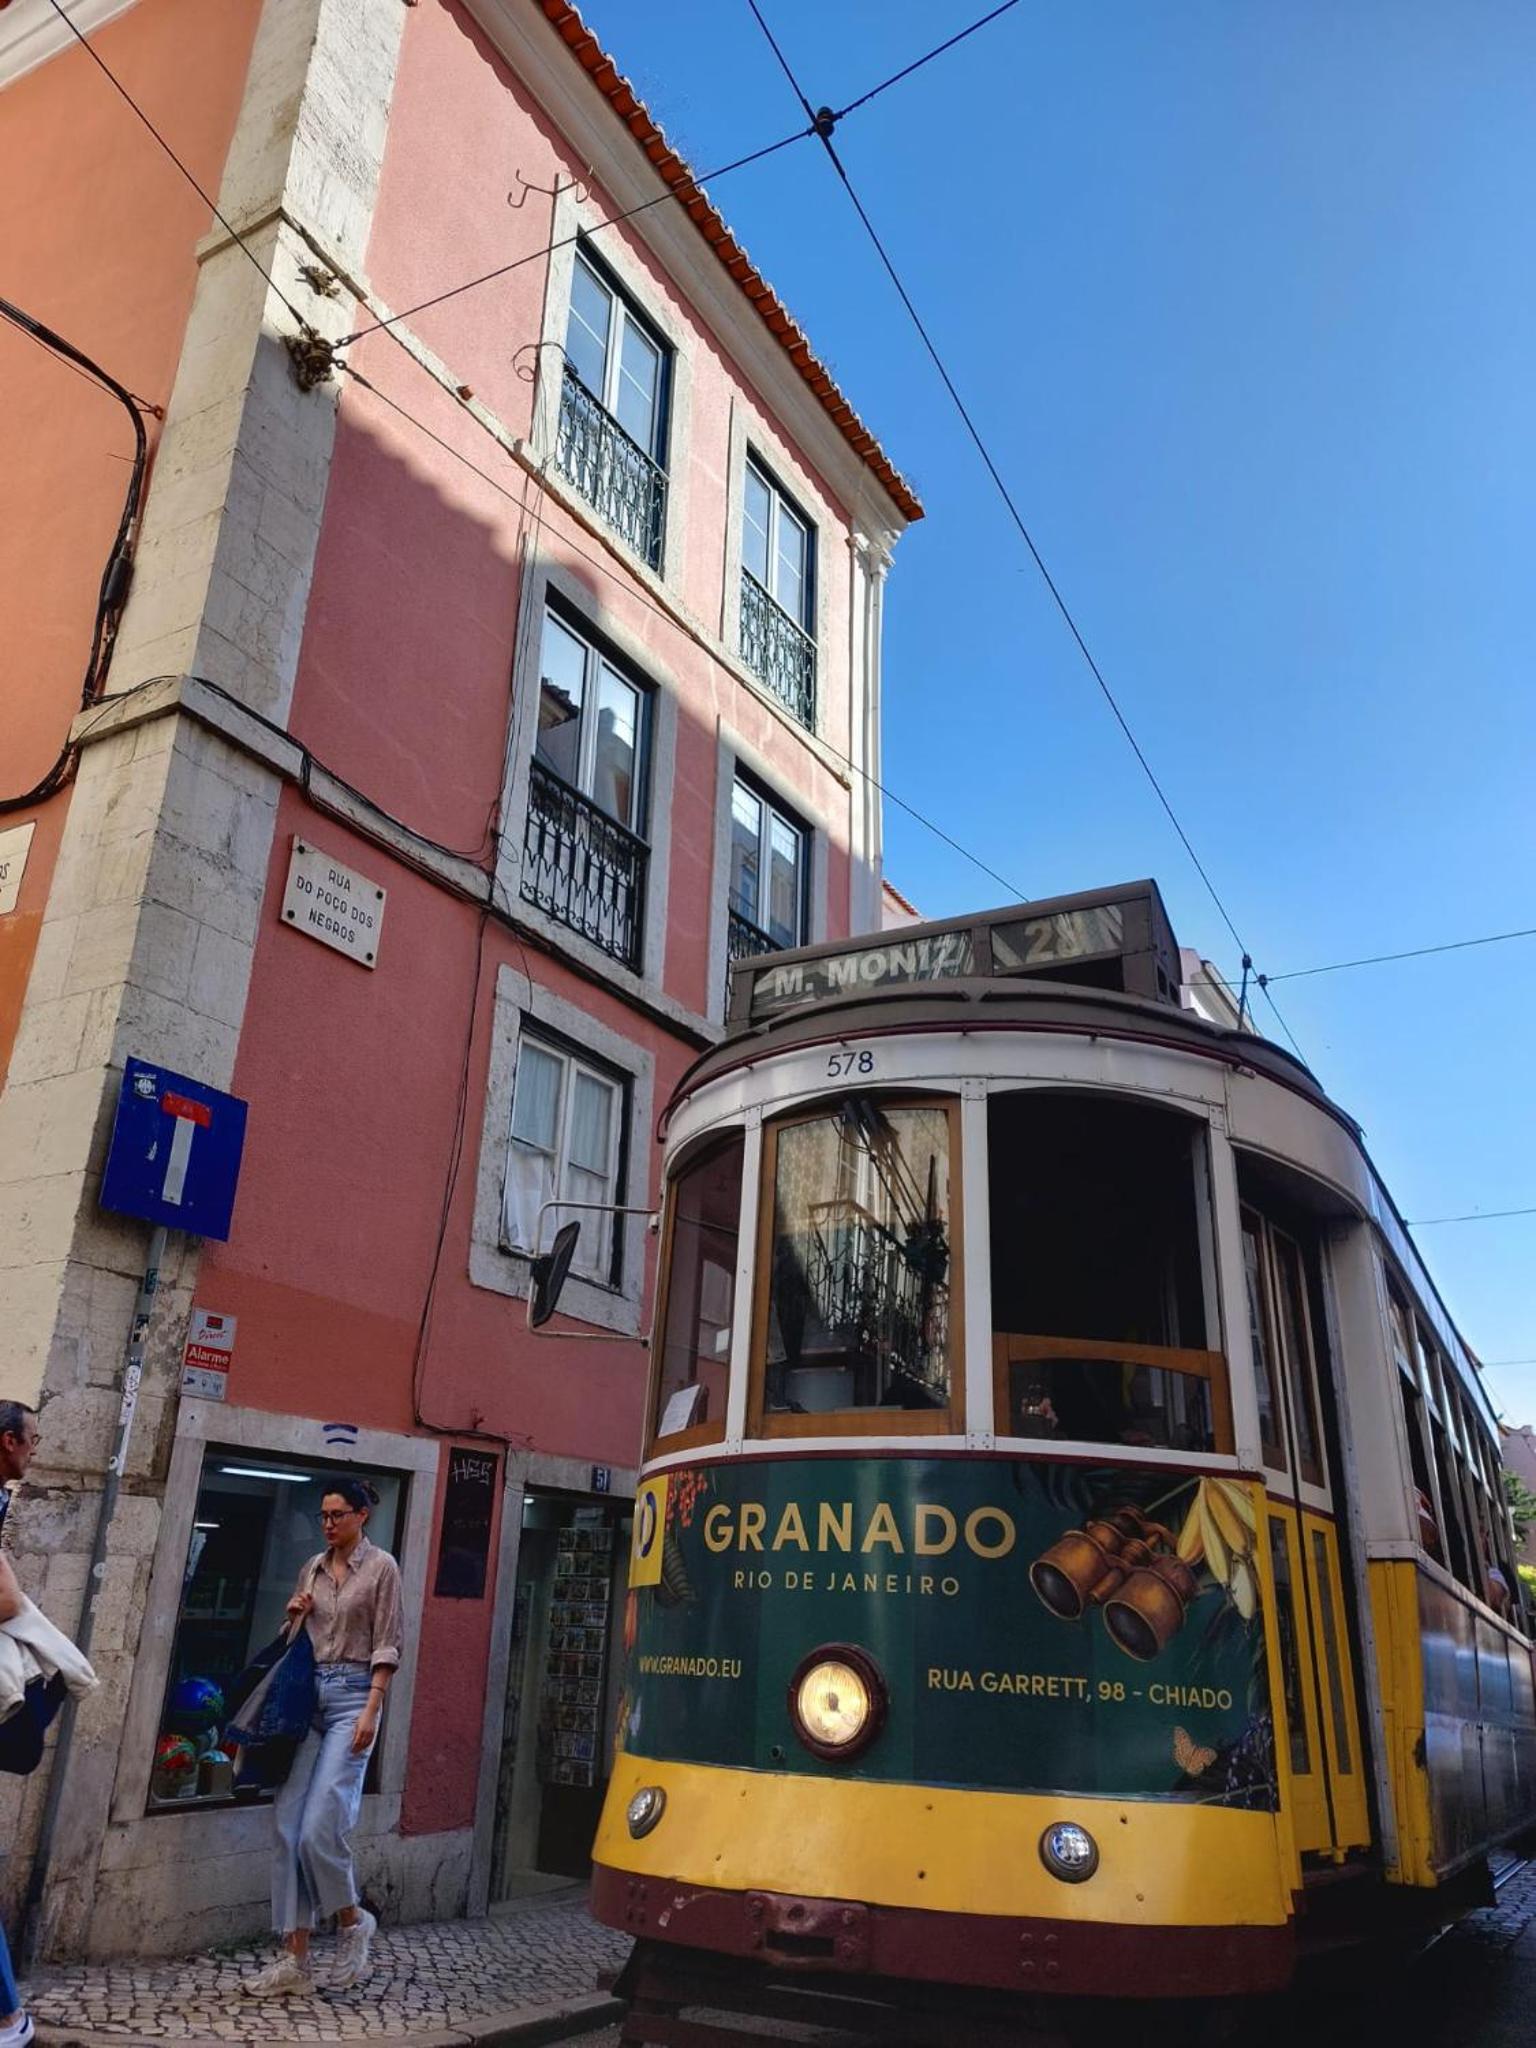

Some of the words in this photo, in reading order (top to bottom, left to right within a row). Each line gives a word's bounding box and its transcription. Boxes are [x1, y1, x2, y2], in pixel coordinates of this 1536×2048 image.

[329, 868, 351, 892] RUA
[296, 875, 313, 894] DO
[350, 906, 373, 928] DOS
[308, 907, 355, 943] NEGROS
[774, 965, 814, 998] M.
[828, 939, 959, 988] MONIZ
[827, 1050, 874, 1078] 578
[188, 1346, 229, 1364] Alarme
[704, 1502, 1017, 1559] GRANADO
[734, 1570, 772, 1590] RIO
[785, 1571, 815, 1591] DE
[826, 1572, 960, 1597] JANEIRO
[928, 1668, 975, 1692] RUA
[980, 1671, 1092, 1703] GARRETT,
[1098, 1680, 1126, 1701] 98
[1149, 1684, 1233, 1710] CHIADO
